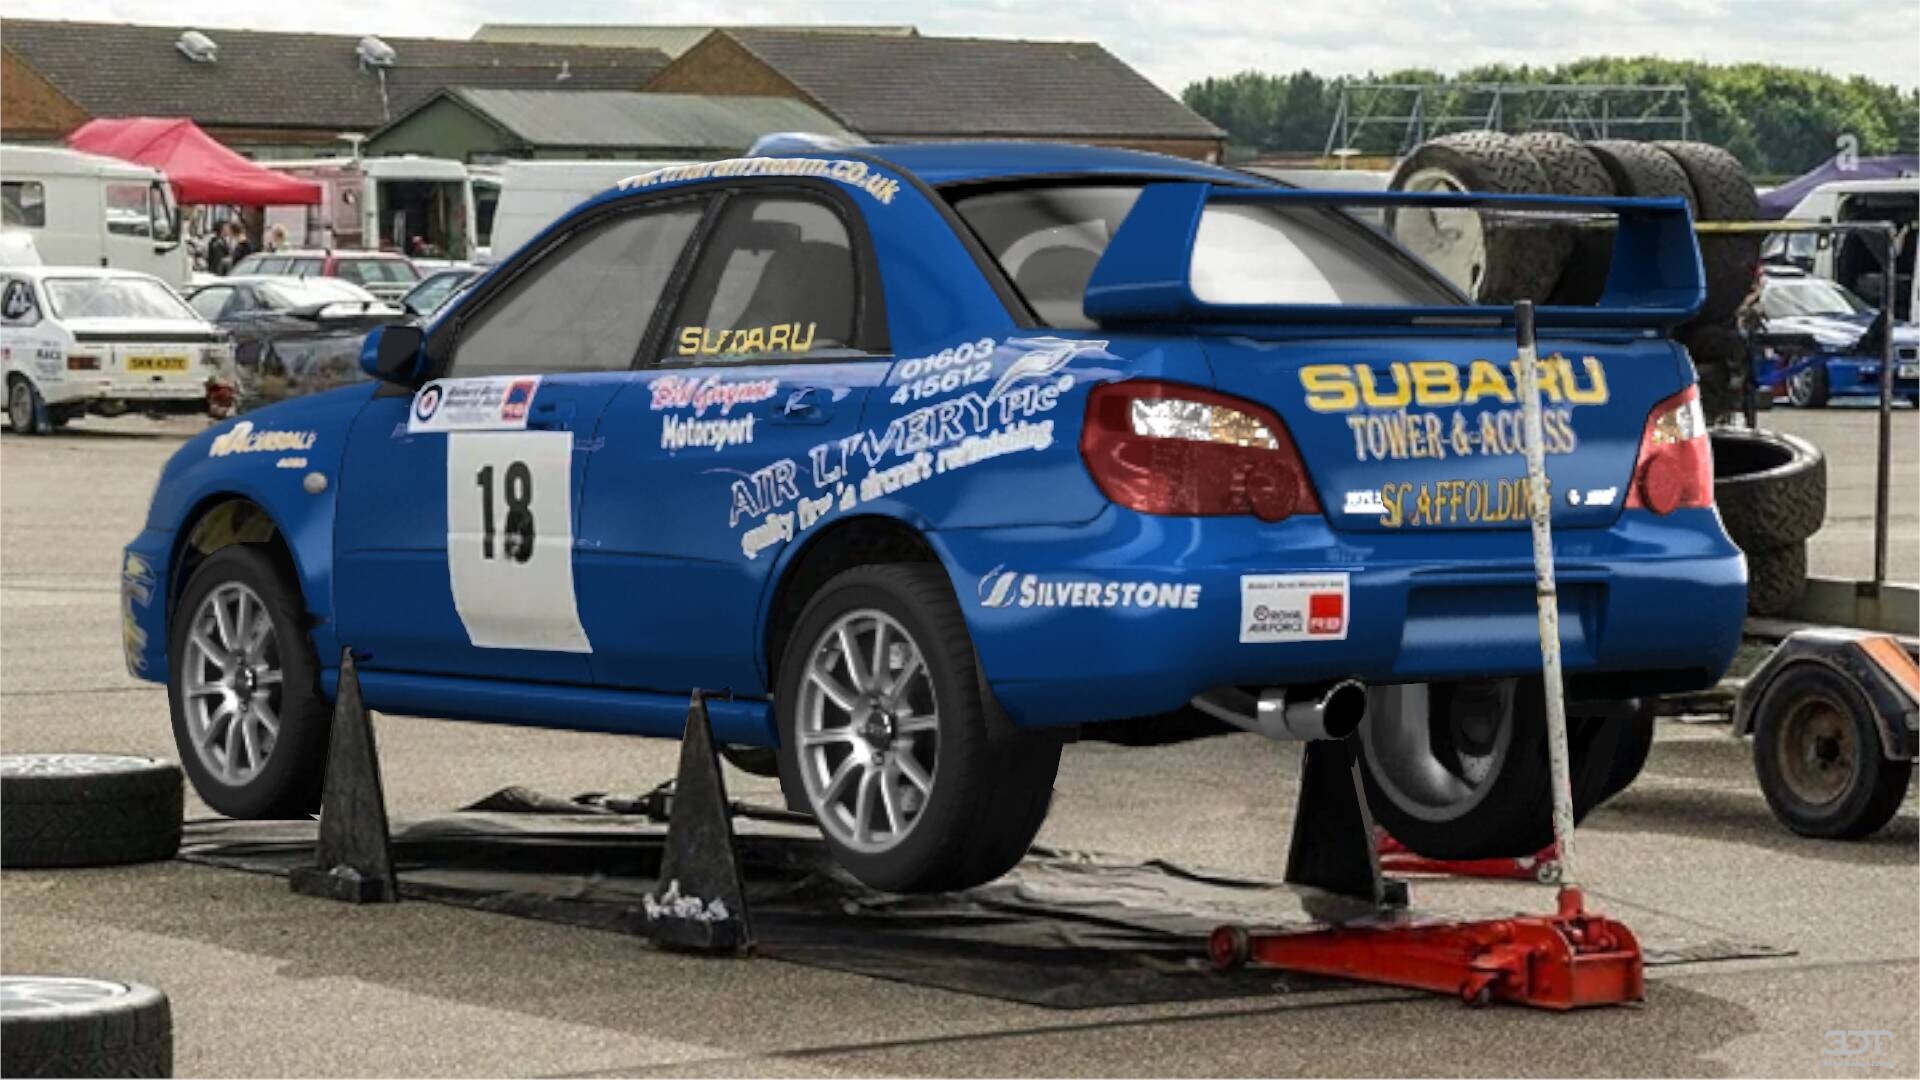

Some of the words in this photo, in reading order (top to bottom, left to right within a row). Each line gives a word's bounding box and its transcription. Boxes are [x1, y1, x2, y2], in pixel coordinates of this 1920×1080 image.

[889, 361, 993, 405] 415612
[900, 337, 996, 379] 01603
[1298, 352, 1609, 413] SUBARU
[660, 412, 755, 452] Motorsport
[1346, 411, 1446, 461] TOWER
[1480, 408, 1578, 456] ACCSS
[476, 460, 535, 564] 18
[728, 458, 800, 528] AIR
[1380, 477, 1553, 528] SCAFFOLDIN
[1018, 573, 1202, 609] SILVERSTONE
